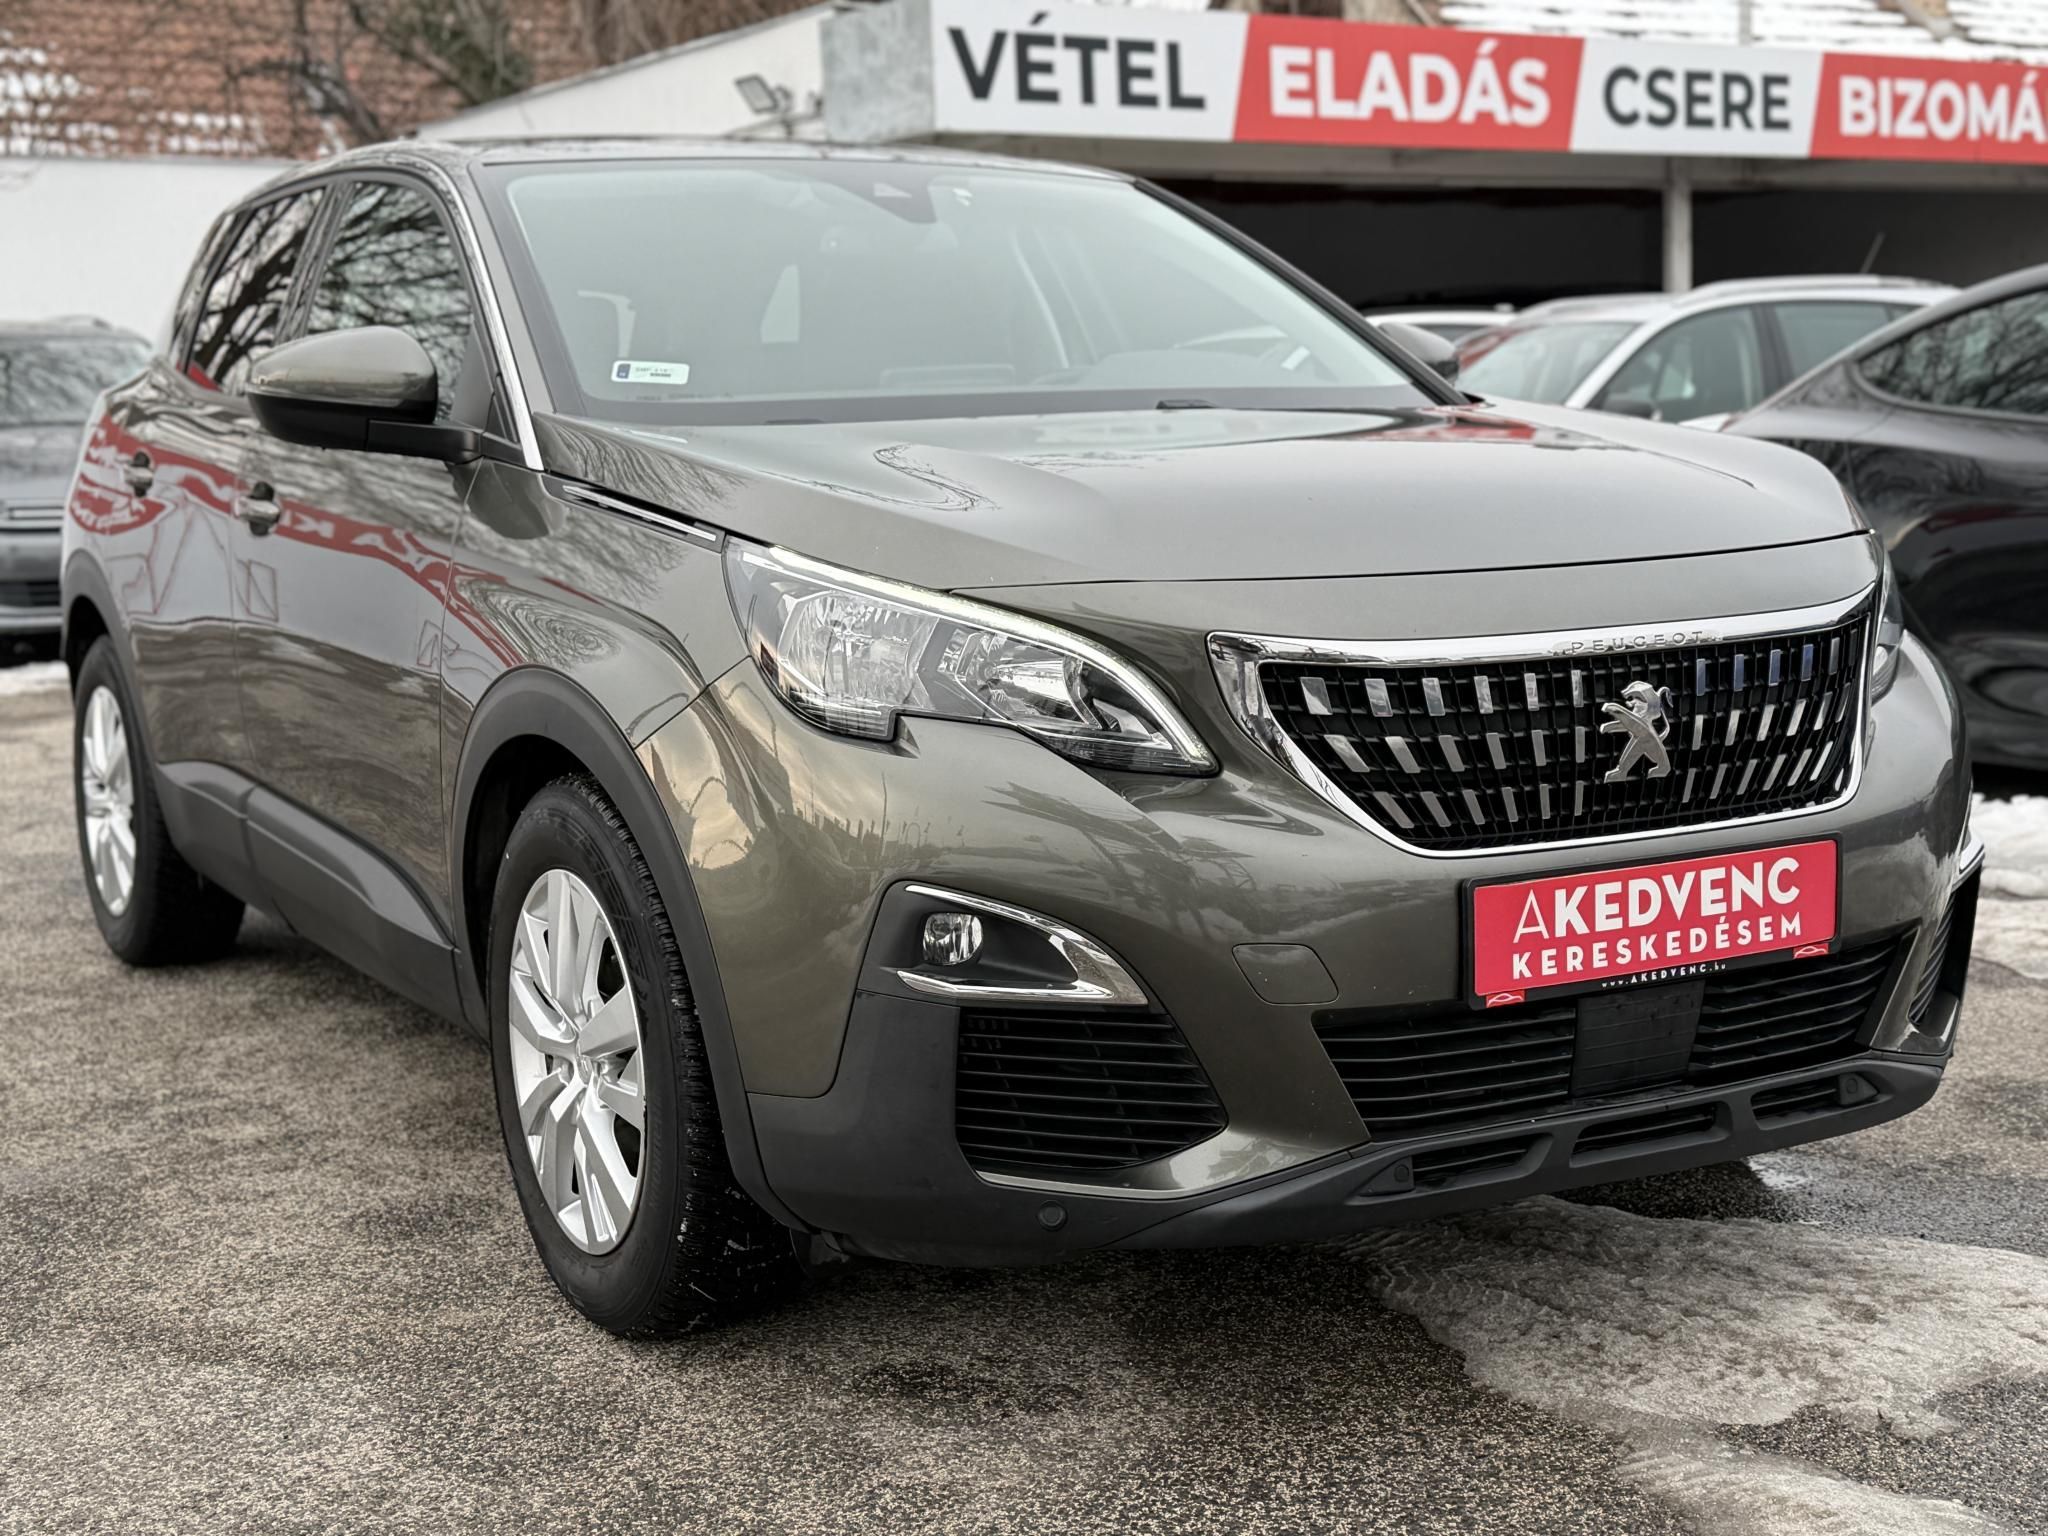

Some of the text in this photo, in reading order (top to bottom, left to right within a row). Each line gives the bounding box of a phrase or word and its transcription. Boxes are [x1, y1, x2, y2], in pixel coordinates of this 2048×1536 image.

[947, 11, 1206, 110] VÉTEL
[1269, 38, 1551, 128] ELADÁS
[1604, 65, 1791, 131] CSERE
[1571, 630, 1703, 654] PEUGEOT
[1512, 911, 1802, 980] KERESKEDÉSEM
